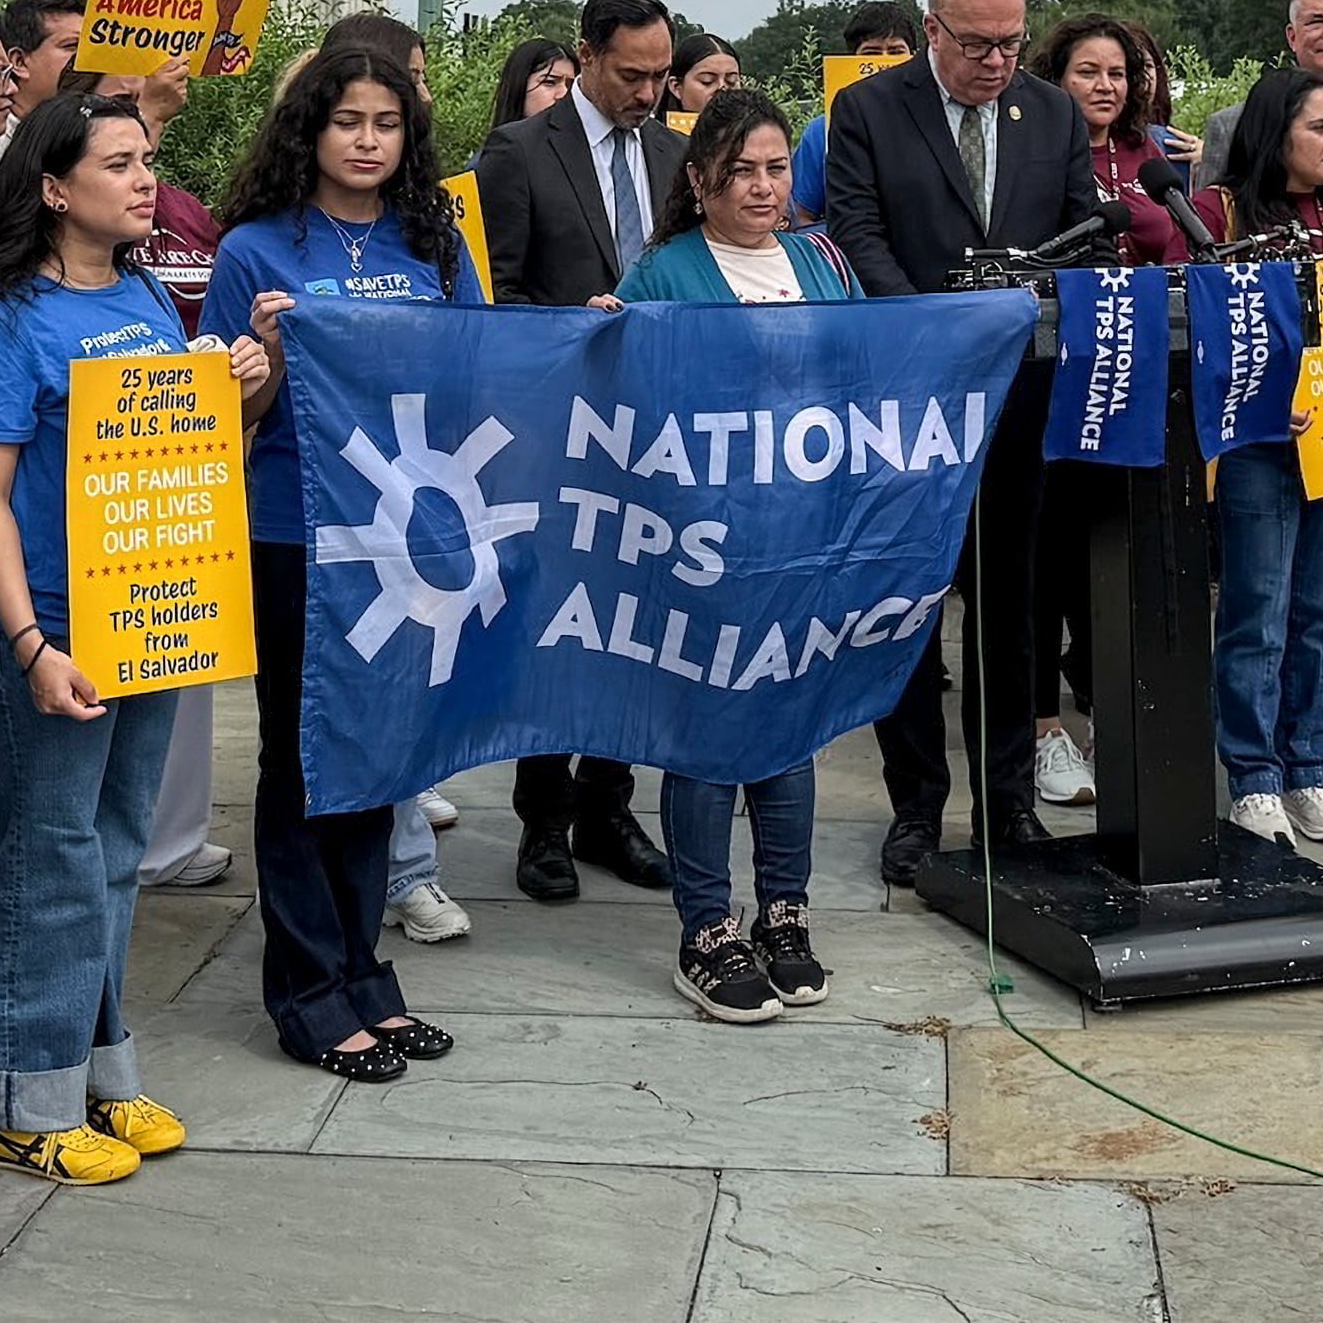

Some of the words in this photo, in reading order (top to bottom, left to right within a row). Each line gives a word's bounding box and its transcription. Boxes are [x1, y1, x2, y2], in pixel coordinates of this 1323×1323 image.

[88, 17, 207, 58] Stronger
[858, 62, 874, 75] 25
[1096, 295, 1114, 340] TPS
[1228, 292, 1247, 336] TPS
[1109, 296, 1134, 416] NATIONAL
[1243, 291, 1269, 403] NATIONAL
[121, 368, 142, 389] 25
[147, 368, 193, 393] years
[1080, 343, 1113, 451] ALLIANCE
[1221, 339, 1248, 441] ALLIANCE
[117, 391, 137, 414] of
[140, 389, 196, 413] calling
[96, 418, 125, 440] the
[130, 415, 164, 437] U.S.
[170, 413, 216, 434] home
[85, 471, 130, 497] OUR
[137, 462, 229, 489] FAMILIES
[105, 499, 149, 525] OUR
[157, 492, 213, 519] LIVES
[105, 528, 149, 553] OUR
[156, 520, 215, 547] FIGHT
[557, 486, 728, 587] TPS
[129, 576, 197, 605] Protect
[108, 608, 145, 633] TPS
[151, 600, 218, 627] holders
[144, 631, 189, 653] from
[536, 581, 952, 692] ALLIANCE
[117, 659, 134, 683] El
[139, 649, 219, 680] Salvador
